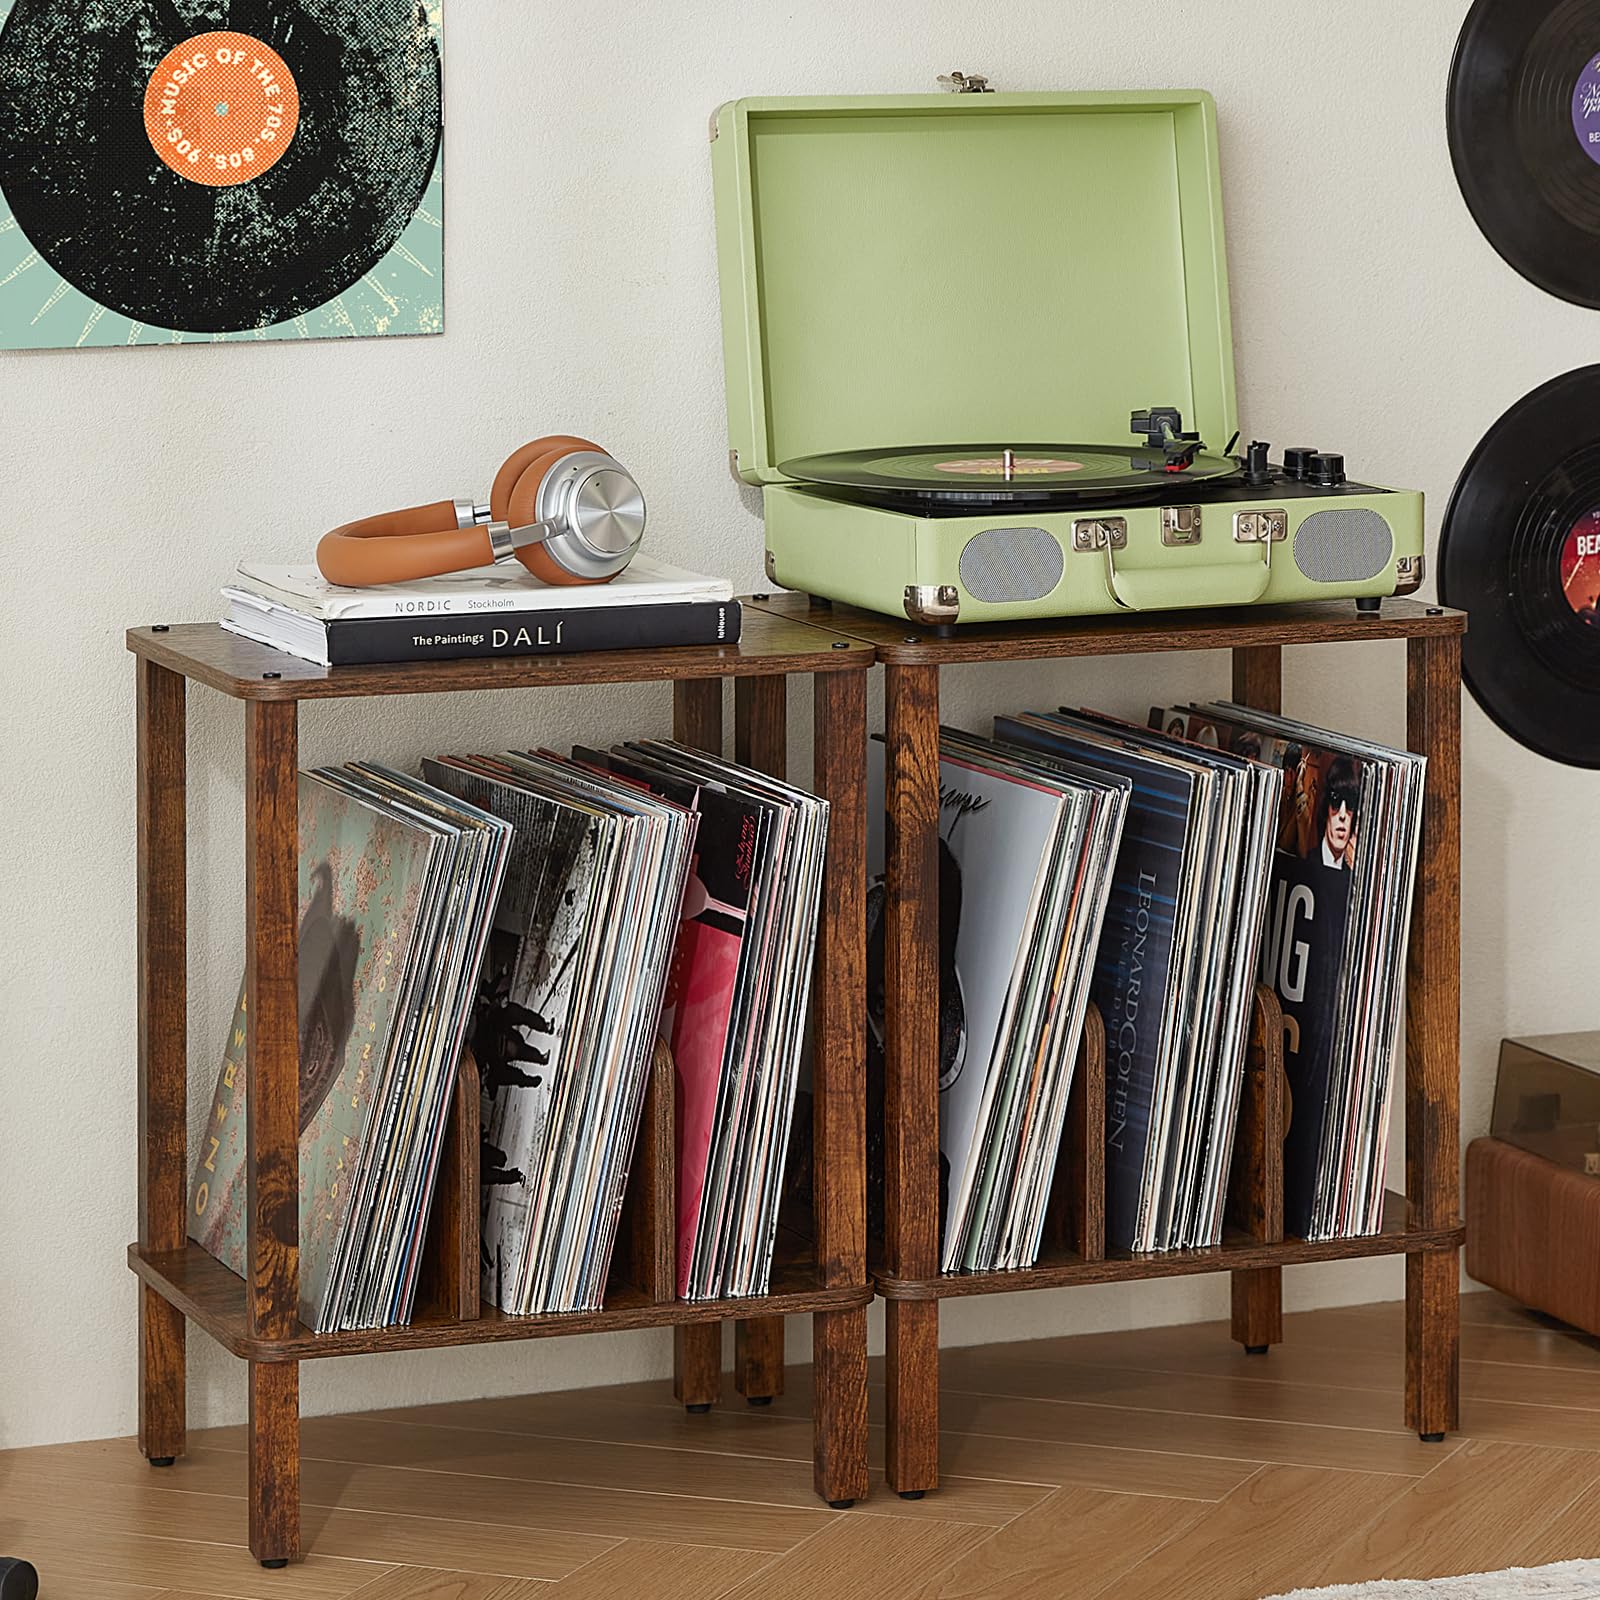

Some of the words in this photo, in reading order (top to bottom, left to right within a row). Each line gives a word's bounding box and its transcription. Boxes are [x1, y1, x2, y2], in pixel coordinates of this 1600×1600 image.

[161, 53, 208, 115] MUSIC
[216, 48, 247, 65] OF
[249, 58, 281, 97] THE
[395, 600, 451, 613] NORDIC
[467, 598, 515, 609] Stockholm
[412, 636, 433, 646] The
[434, 633, 485, 646] Paintings
[492, 621, 564, 648] DALÍ
[325, 1135, 350, 1220] LOVE
[351, 1022, 376, 1109] RUNS
[378, 930, 398, 993] OUT
